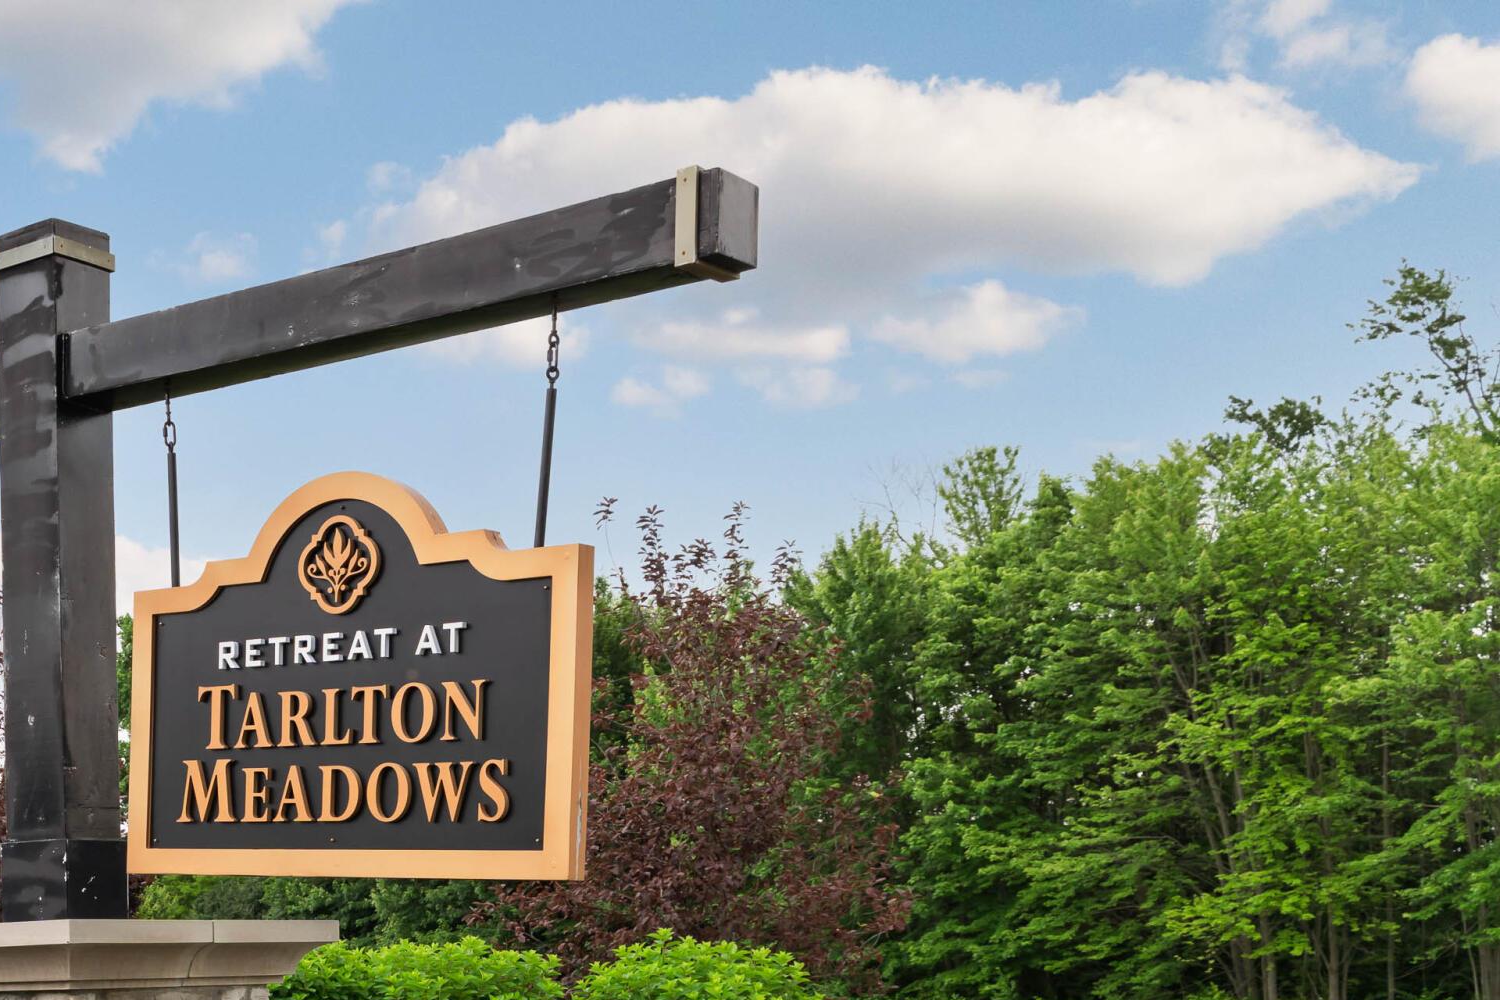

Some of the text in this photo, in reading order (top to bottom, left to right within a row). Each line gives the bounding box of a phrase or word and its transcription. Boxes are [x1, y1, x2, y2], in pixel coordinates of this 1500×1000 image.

[218, 621, 468, 670] RETREAT AT
[198, 679, 490, 750] TARLTON
[176, 758, 510, 823] MEADOWS
